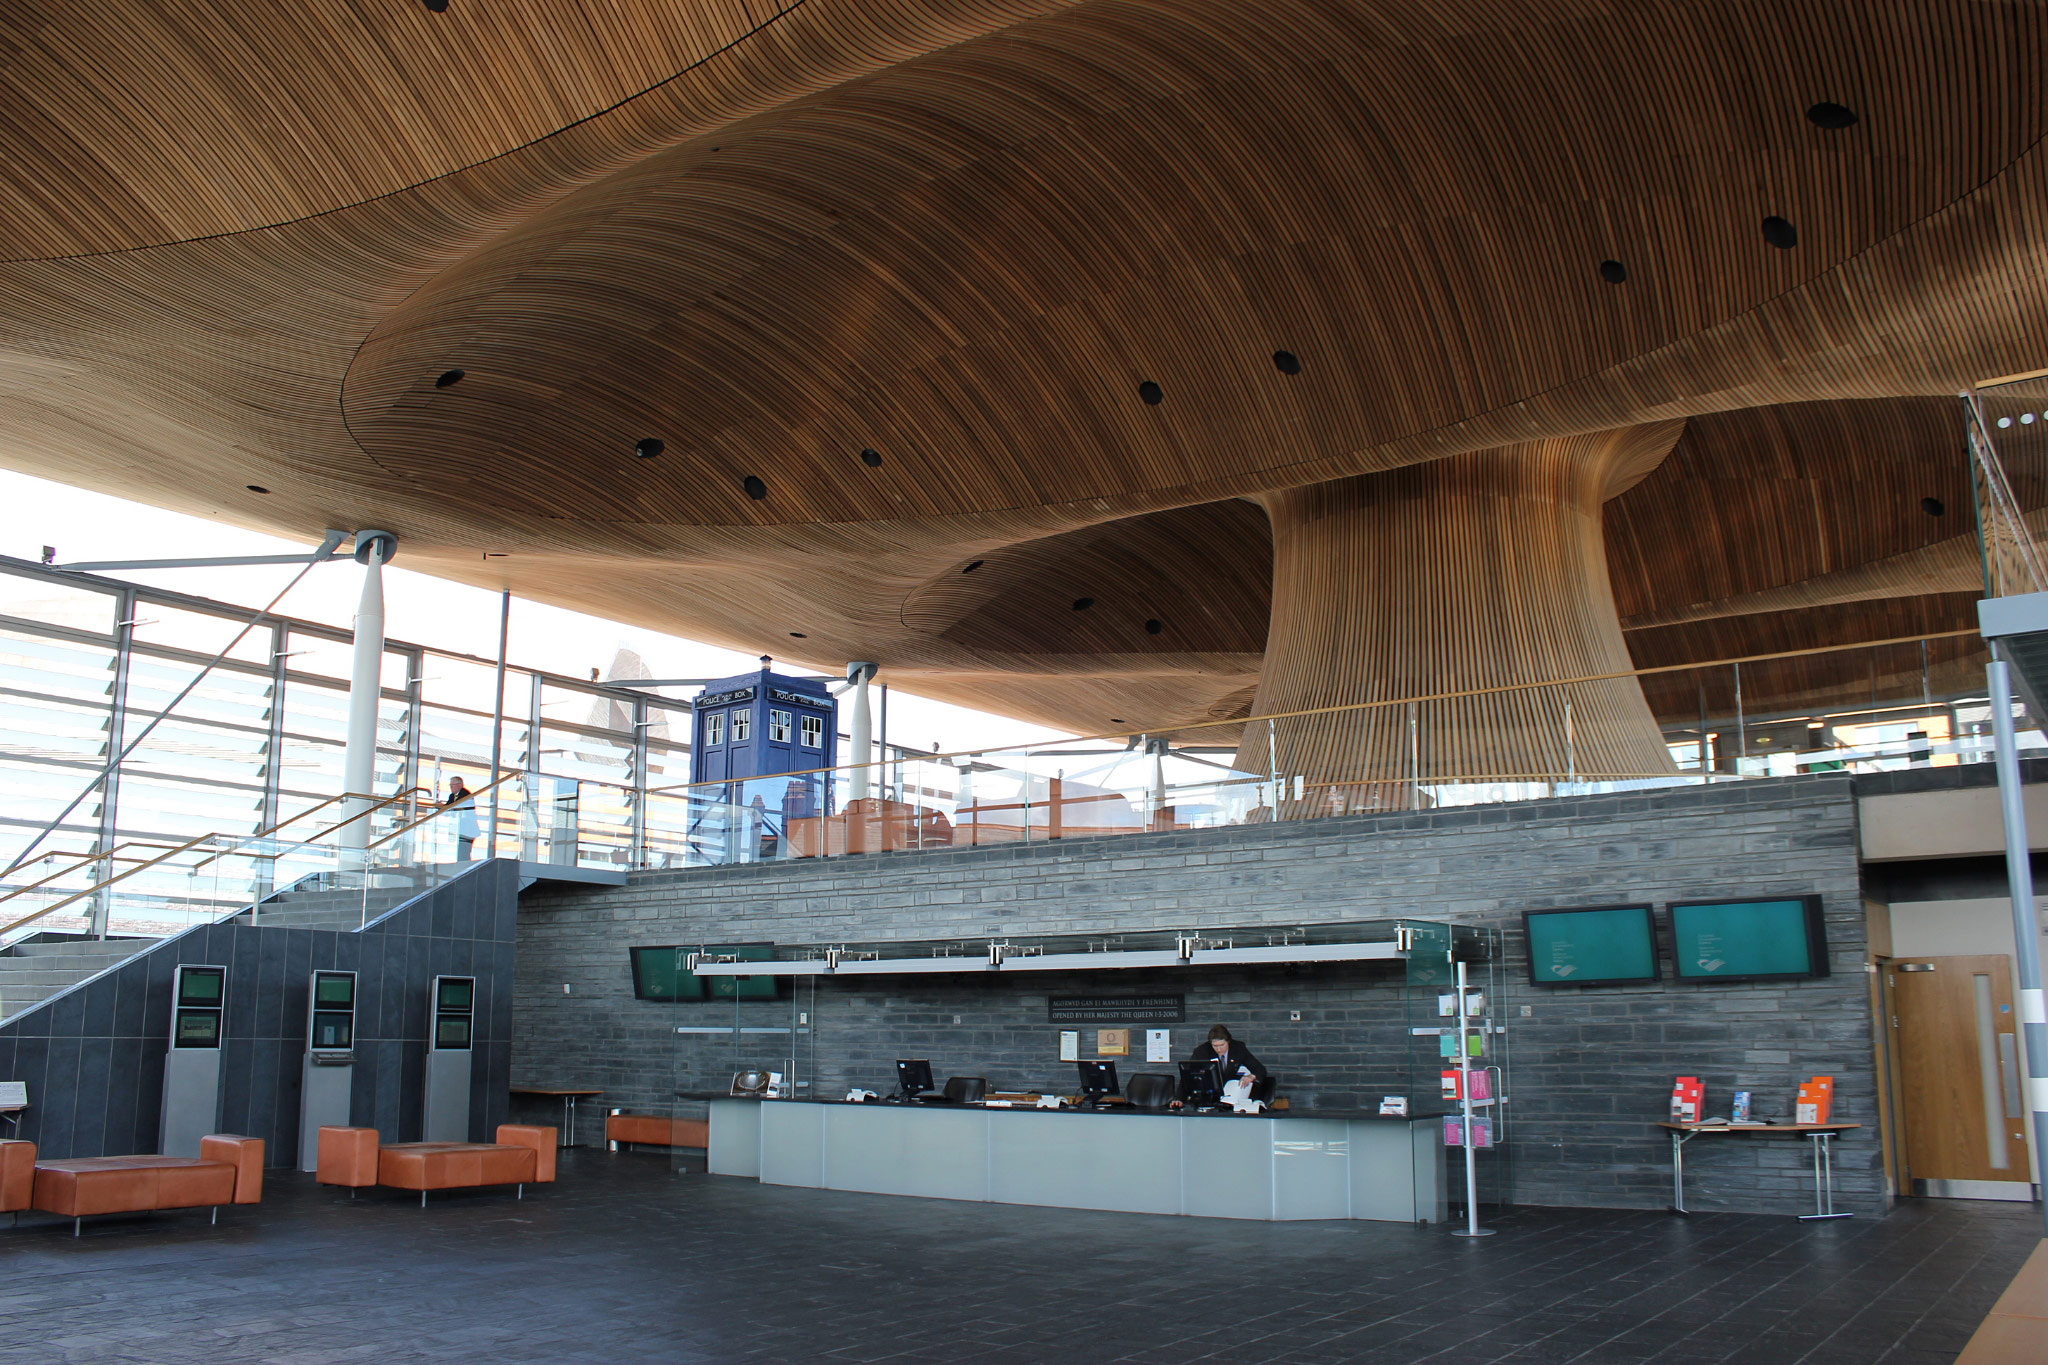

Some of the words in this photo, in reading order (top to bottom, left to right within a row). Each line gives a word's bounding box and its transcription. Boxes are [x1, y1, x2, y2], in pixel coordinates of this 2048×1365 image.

[703, 695, 720, 705] POLICE
[735, 691, 746, 699] BOX
[776, 692, 796, 701] POLICE
